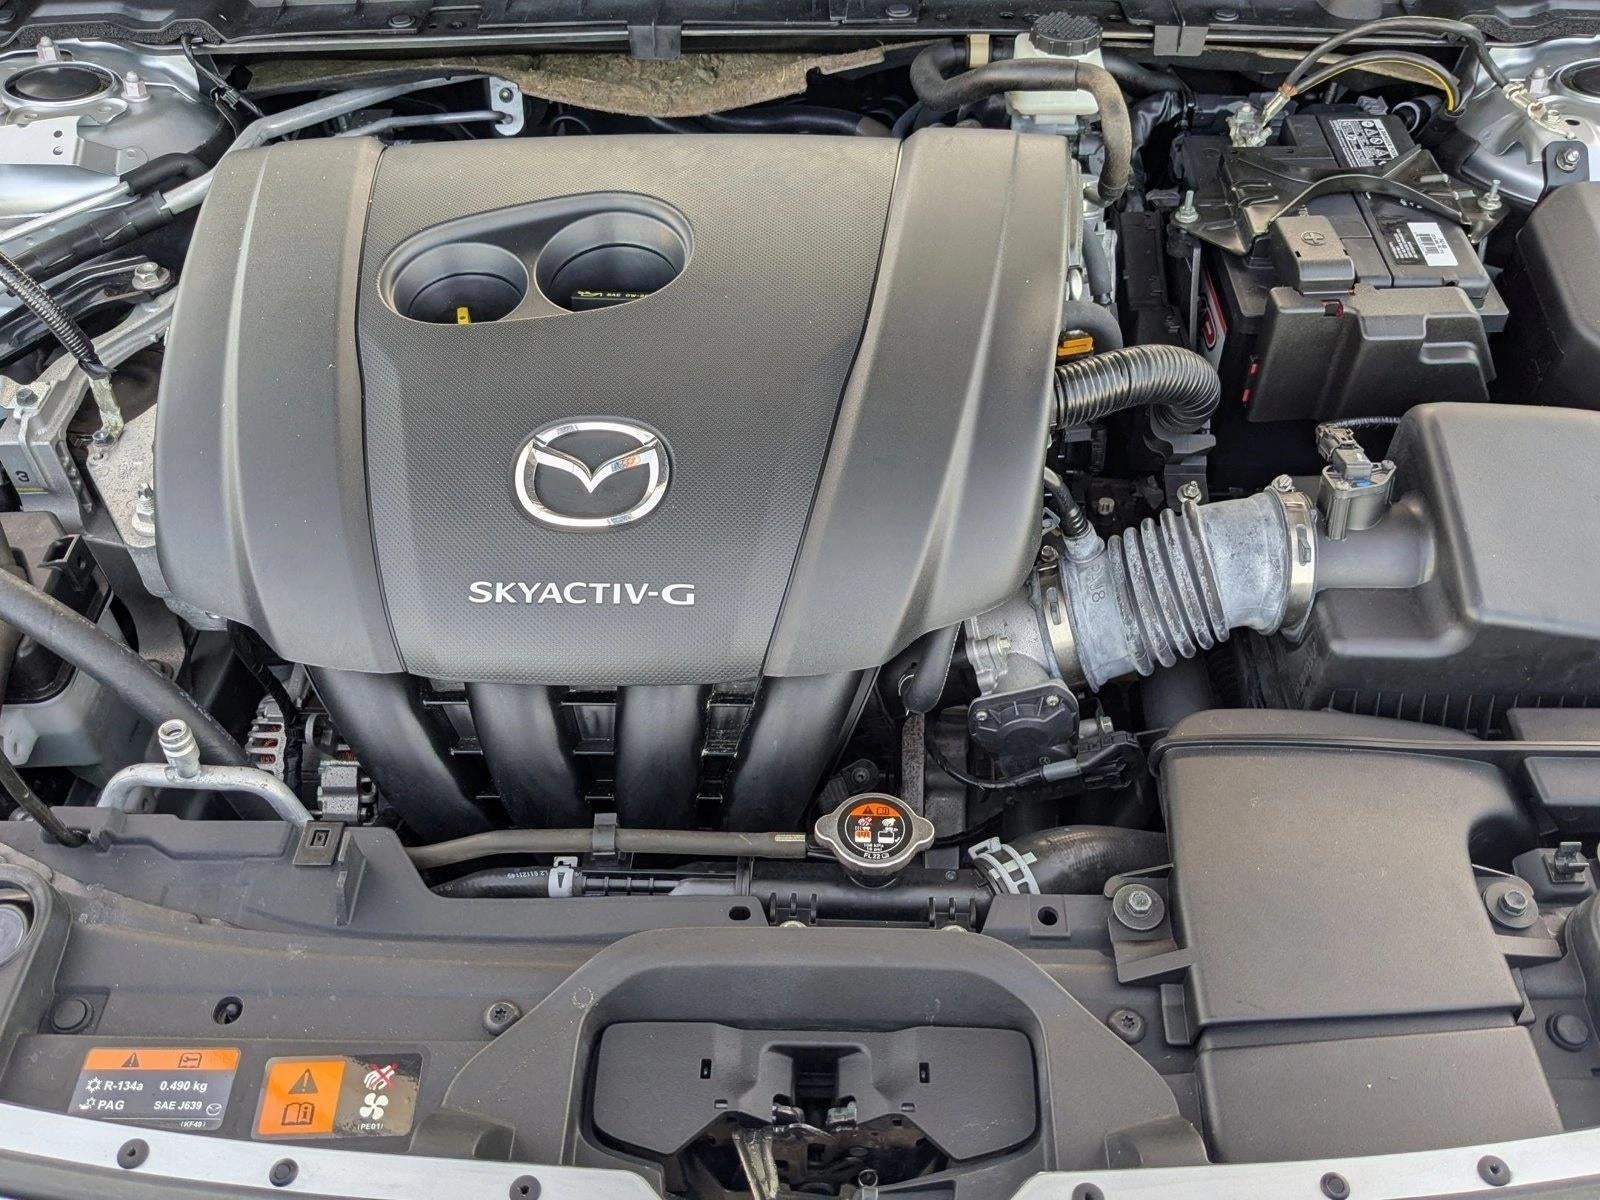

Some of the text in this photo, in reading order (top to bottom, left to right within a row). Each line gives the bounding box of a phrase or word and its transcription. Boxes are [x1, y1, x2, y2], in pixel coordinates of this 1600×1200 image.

[15, 470, 30, 482] 3
[468, 581, 695, 606] SKYACTIV-G
[104, 1081, 208, 1092] R-134a 0.490 kg
[97, 1100, 203, 1110] PAG SAE J639
